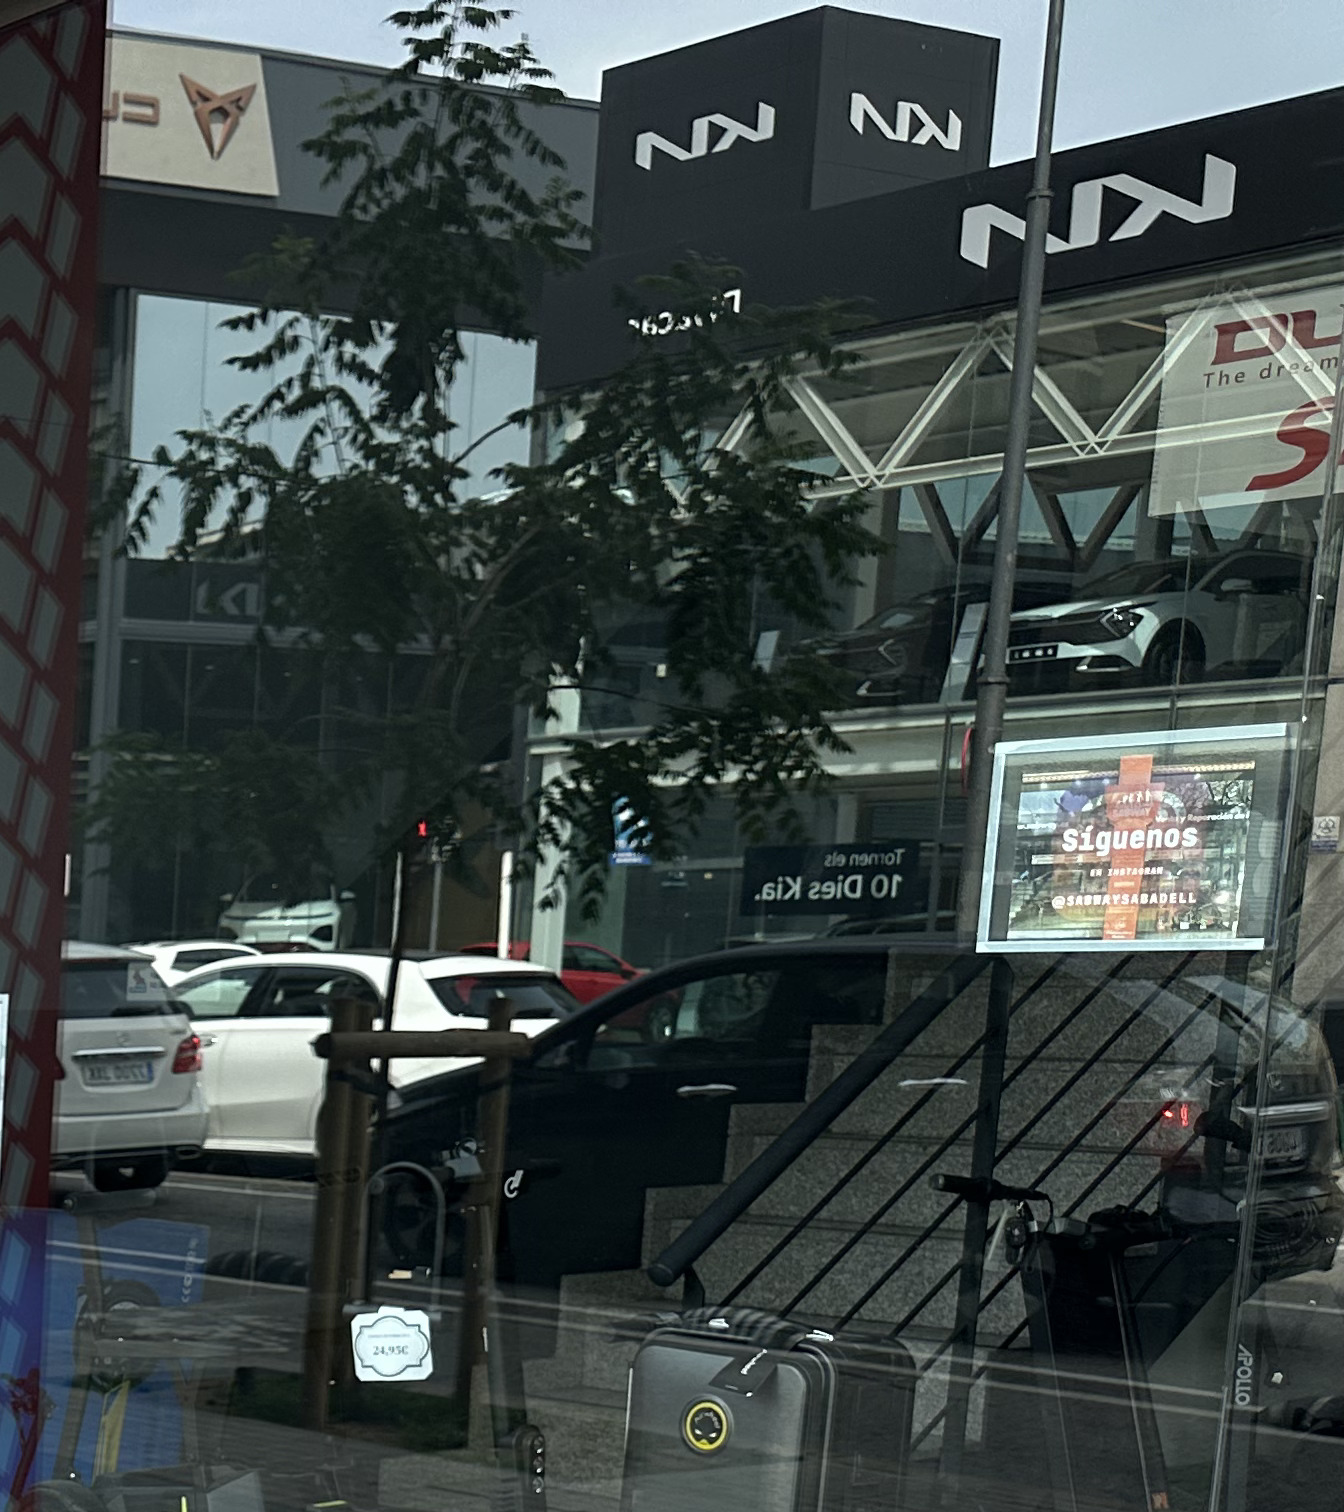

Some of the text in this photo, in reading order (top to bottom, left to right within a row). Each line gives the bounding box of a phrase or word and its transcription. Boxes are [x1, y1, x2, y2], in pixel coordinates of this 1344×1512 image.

[1203, 371, 1245, 388] The
[1062, 824, 1198, 857] Síguenos
[1052, 892, 1198, 909] @SABWAYSABADELL
[373, 1345, 409, 1356] 24,95€
[1234, 1343, 1254, 1406] APOLLO
